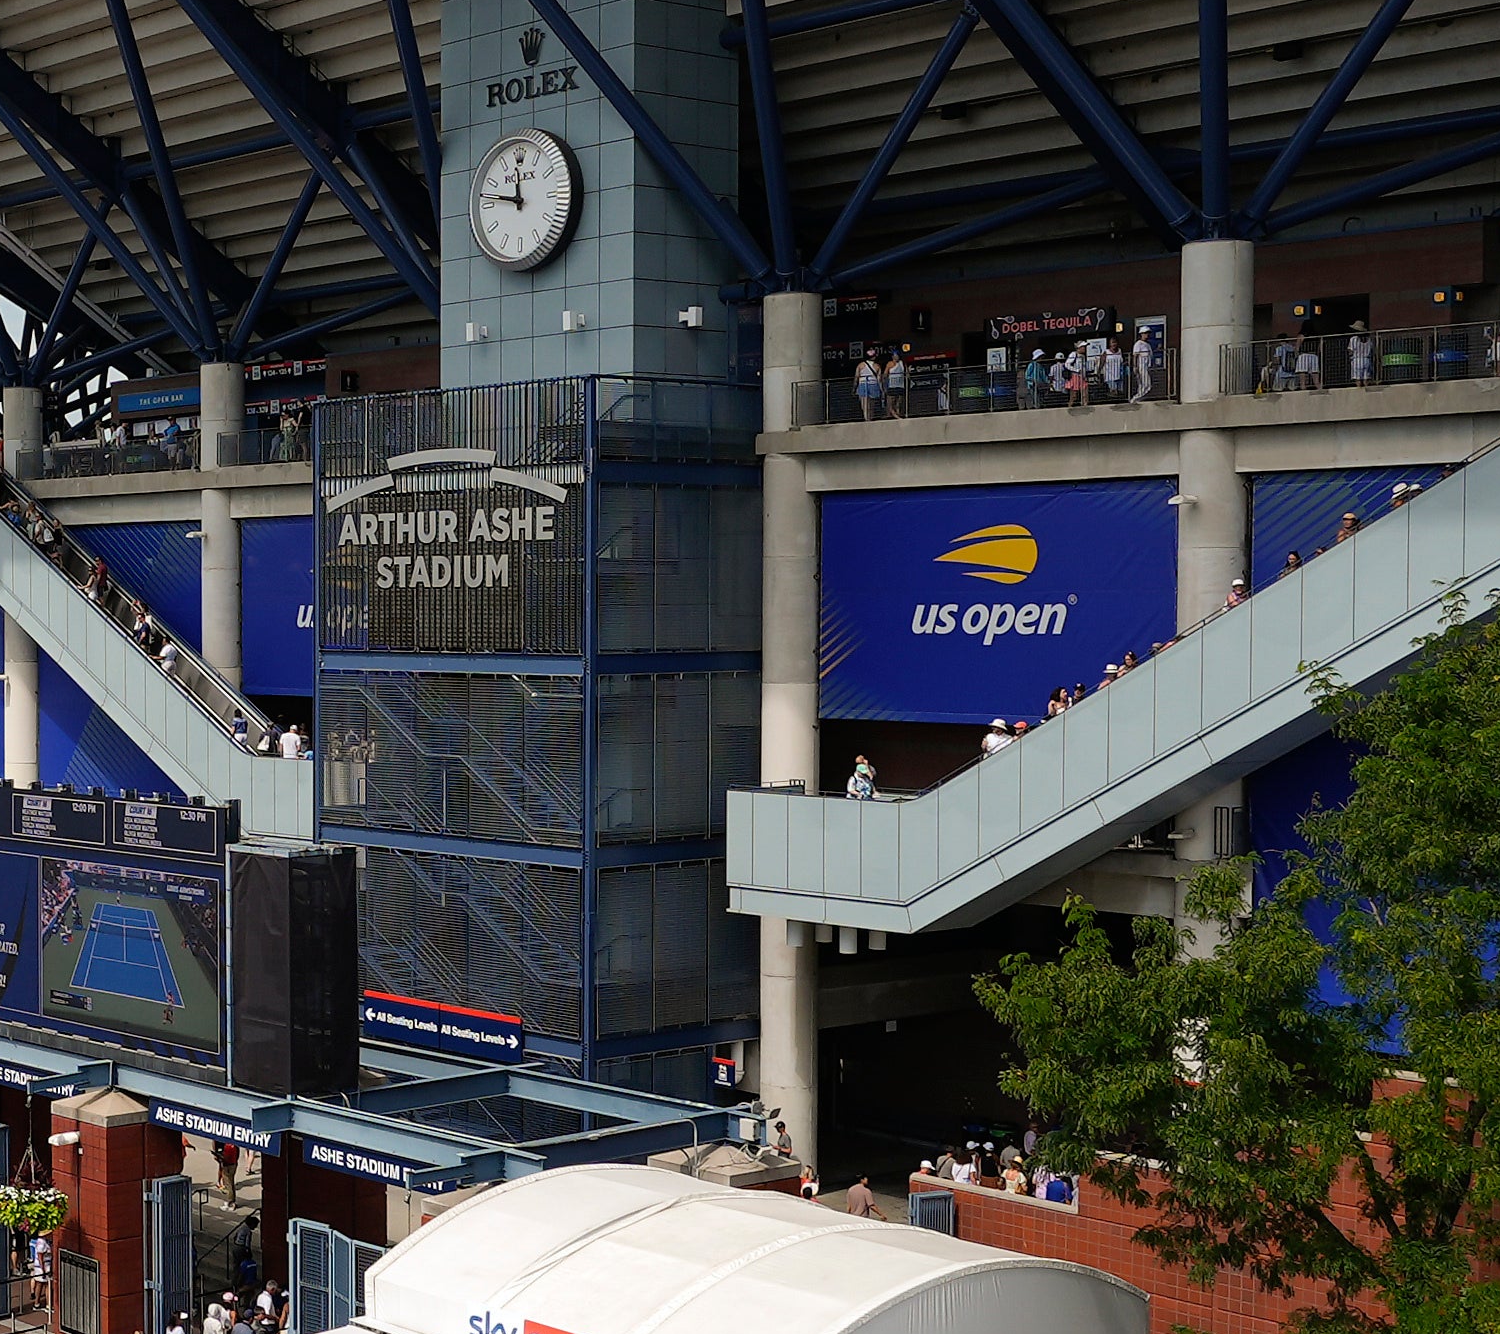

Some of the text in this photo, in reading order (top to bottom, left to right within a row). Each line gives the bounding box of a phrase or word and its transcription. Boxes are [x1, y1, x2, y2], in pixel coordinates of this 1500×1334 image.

[486, 66, 580, 108] ROLEX
[1002, 316, 1092, 335] DOBEL TEQUILA
[338, 506, 555, 546] ARTHUR ASHE
[375, 554, 509, 590] STADIUM
[911, 603, 1068, 646] us open
[376, 1011, 437, 1033] All Seating Levels
[440, 1024, 506, 1046] All Seating Levels
[155, 1106, 184, 1126] ASHE
[185, 1114, 232, 1138] STADIUM
[311, 1144, 344, 1166] ASHE
[346, 1153, 400, 1182] STADIUM
